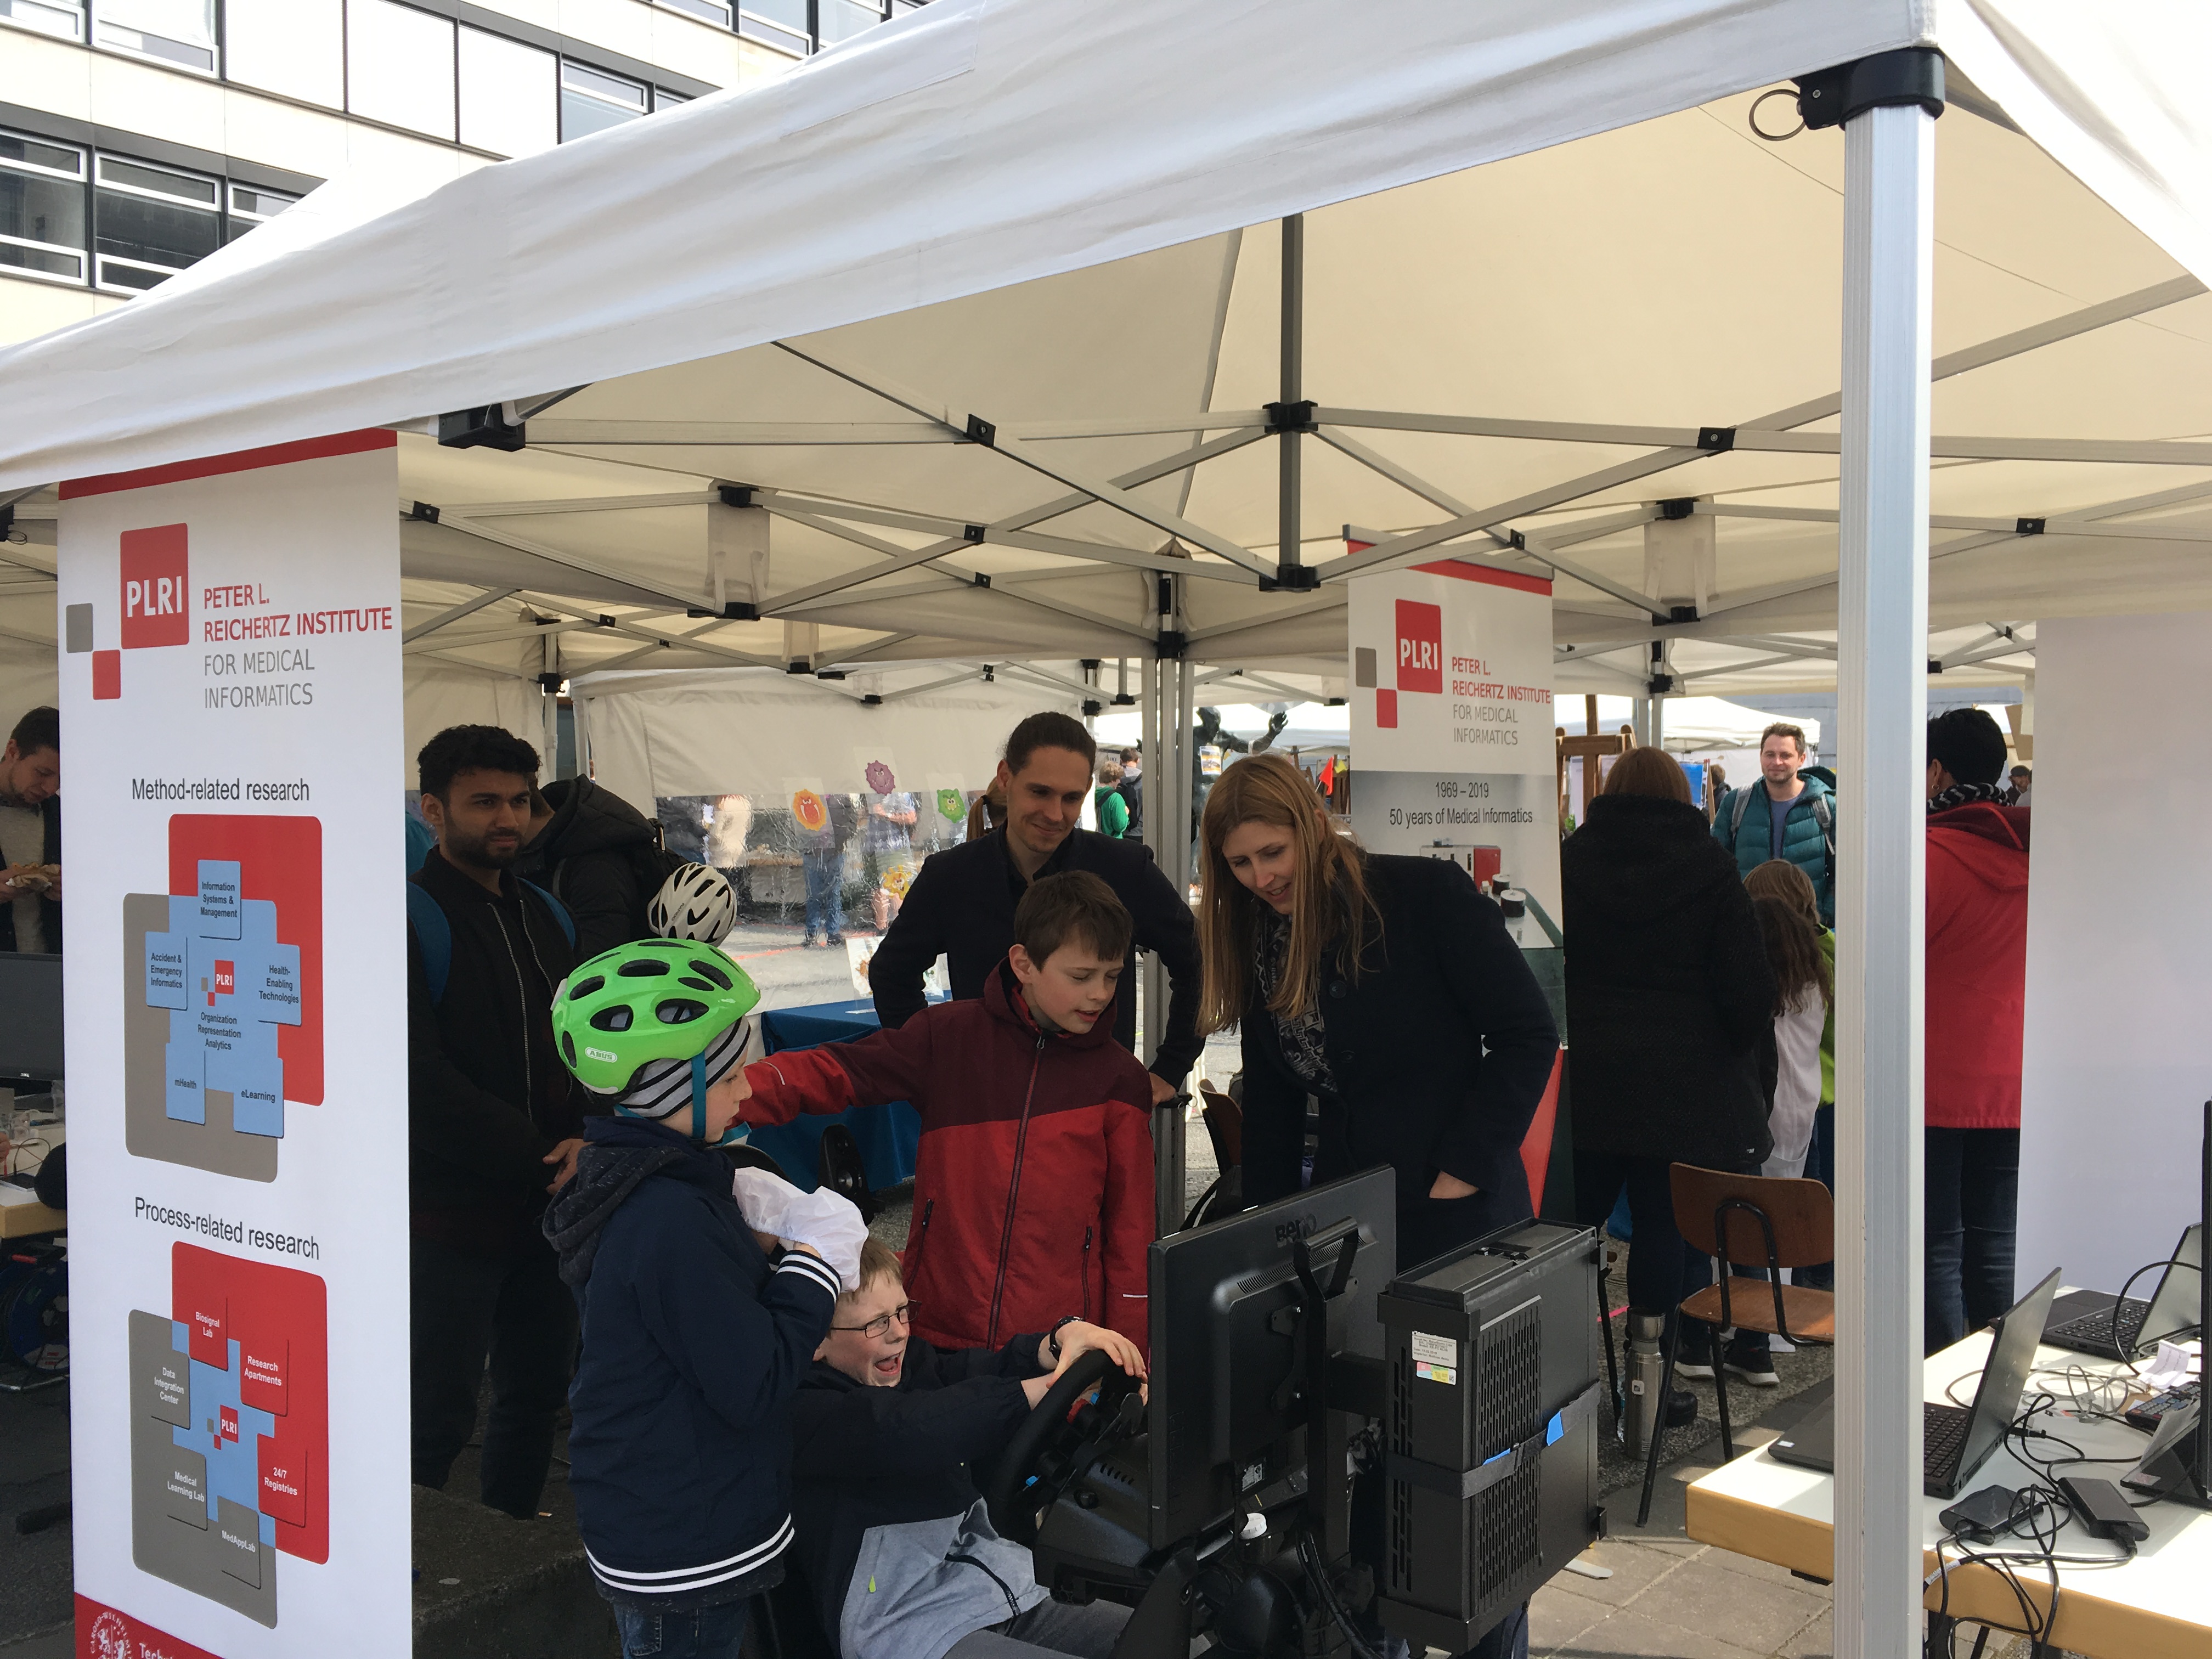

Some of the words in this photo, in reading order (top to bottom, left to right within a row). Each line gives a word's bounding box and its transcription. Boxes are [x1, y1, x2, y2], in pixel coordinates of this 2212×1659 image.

[127, 575, 183, 618] PLRI
[204, 585, 253, 610] PETER
[258, 583, 270, 605] L.
[204, 615, 290, 642] REICHERTZ
[297, 607, 392, 635] INSTITUTE
[205, 654, 236, 676] FOR
[243, 648, 315, 674] MEDICAL
[1400, 638, 1438, 670] PLRI
[1452, 656, 1480, 675] PETER
[1483, 661, 1491, 676] L.
[205, 683, 313, 709] INFORMATICS
[1453, 680, 1504, 699] REICHERTZ
[1508, 686, 1550, 704] INSTITUTE
[1453, 704, 1471, 720] FOR
[1475, 706, 1519, 723] MEDICAL
[1453, 727, 1518, 746] INFORMATICS
[132, 778, 240, 800] Method-related
[246, 778, 309, 800] research
[1435, 781, 1458, 798] 1969
[1469, 782, 1489, 798] 2019
[1390, 808, 1402, 825] 50
[1406, 811, 1432, 829] years
[1435, 808, 1446, 823] of
[1447, 808, 1481, 823] Medical
[1482, 808, 1532, 823] Informatics
[202, 882, 235, 891] Information
[202, 894, 227, 905] Systems
[229, 896, 234, 905] &
[200, 907, 237, 918] Management
[151, 953, 176, 963] Accident
[150, 964, 182, 977] Emergency
[269, 964, 290, 975] Health-
[151, 978, 182, 989] Informatics
[216, 974, 233, 986] PLRI
[266, 978, 292, 991] Enabling
[259, 991, 299, 1004] Technologies
[201, 1012, 237, 1025] Organization
[198, 1024, 241, 1039] Representation
[205, 1038, 232, 1051] Analytics
[590, 1051, 612, 1060] ABUS
[174, 1079, 196, 1090] mHealth
[241, 1089, 275, 1103] eLearning
[135, 1197, 242, 1244] Process-related
[249, 1229, 319, 1260] research
[196, 1311, 219, 1328] Biosignal
[203, 1327, 213, 1338] Lab
[247, 1356, 278, 1372] Research
[162, 1367, 176, 1379] Data
[244, 1368, 281, 1386] Apartments
[154, 1377, 184, 1394] Integration
[160, 1391, 179, 1404] Center
[222, 1419, 237, 1434] PLRI
[175, 1471, 196, 1487] Medical
[273, 1467, 287, 1479] 24/7
[167, 1482, 193, 1499] Learning
[194, 1490, 205, 1503] Lab
[264, 1477, 297, 1496] Registries
[222, 1530, 256, 1553] MedAppLab
